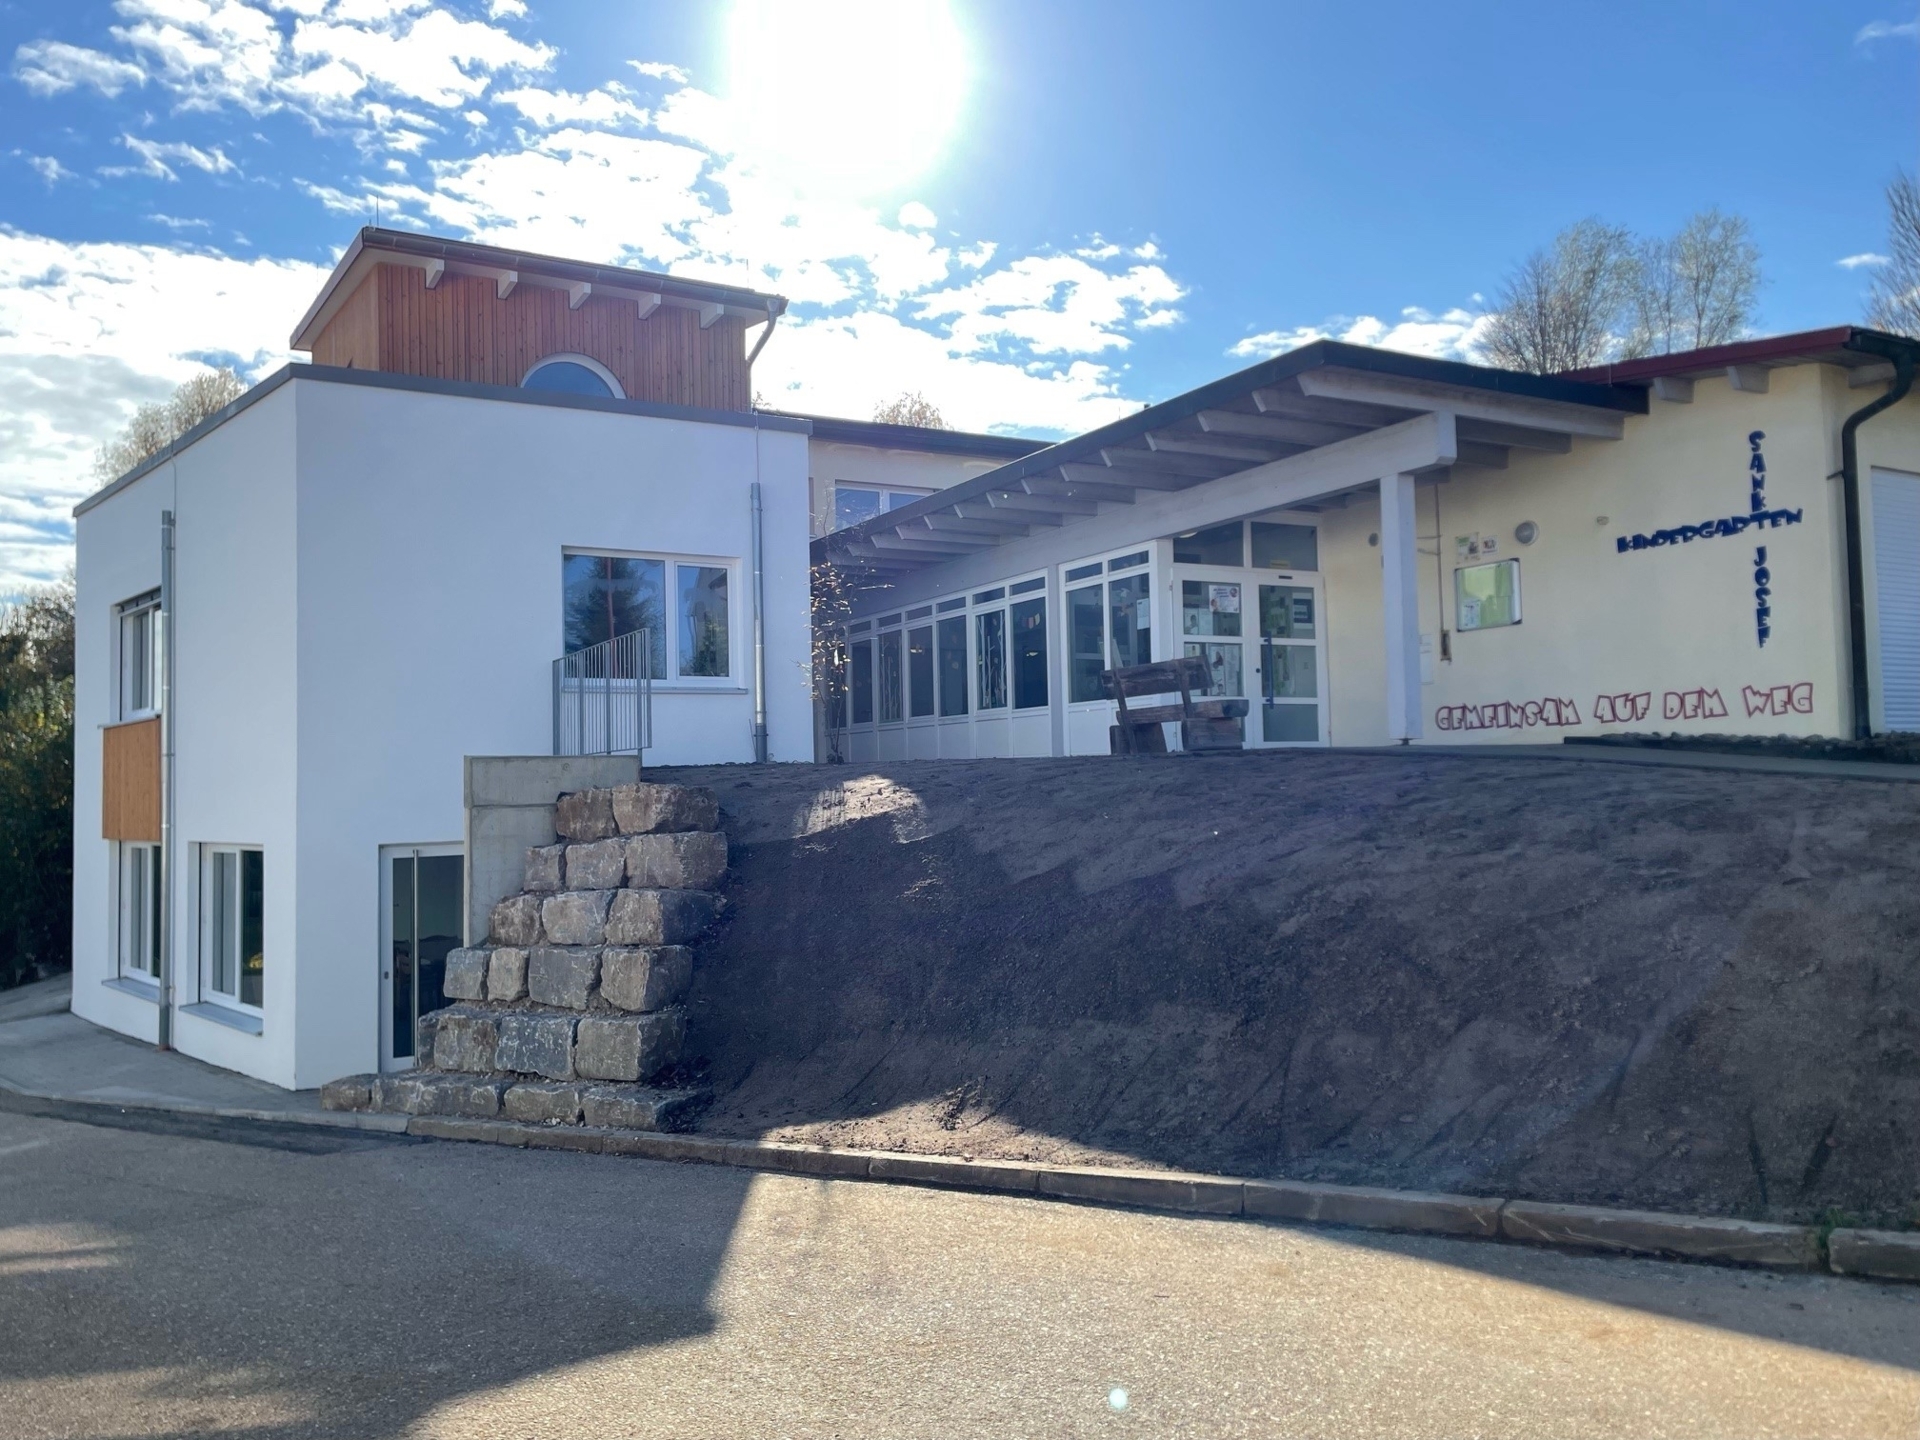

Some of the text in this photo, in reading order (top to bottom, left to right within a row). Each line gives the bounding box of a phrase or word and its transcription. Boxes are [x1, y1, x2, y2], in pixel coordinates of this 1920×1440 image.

[1616, 508, 1803, 554] KINDERGARTEN
[1753, 546, 1771, 649] JOSEF
[1435, 682, 1814, 730] GEMEINSAM AUF DEM WEG
